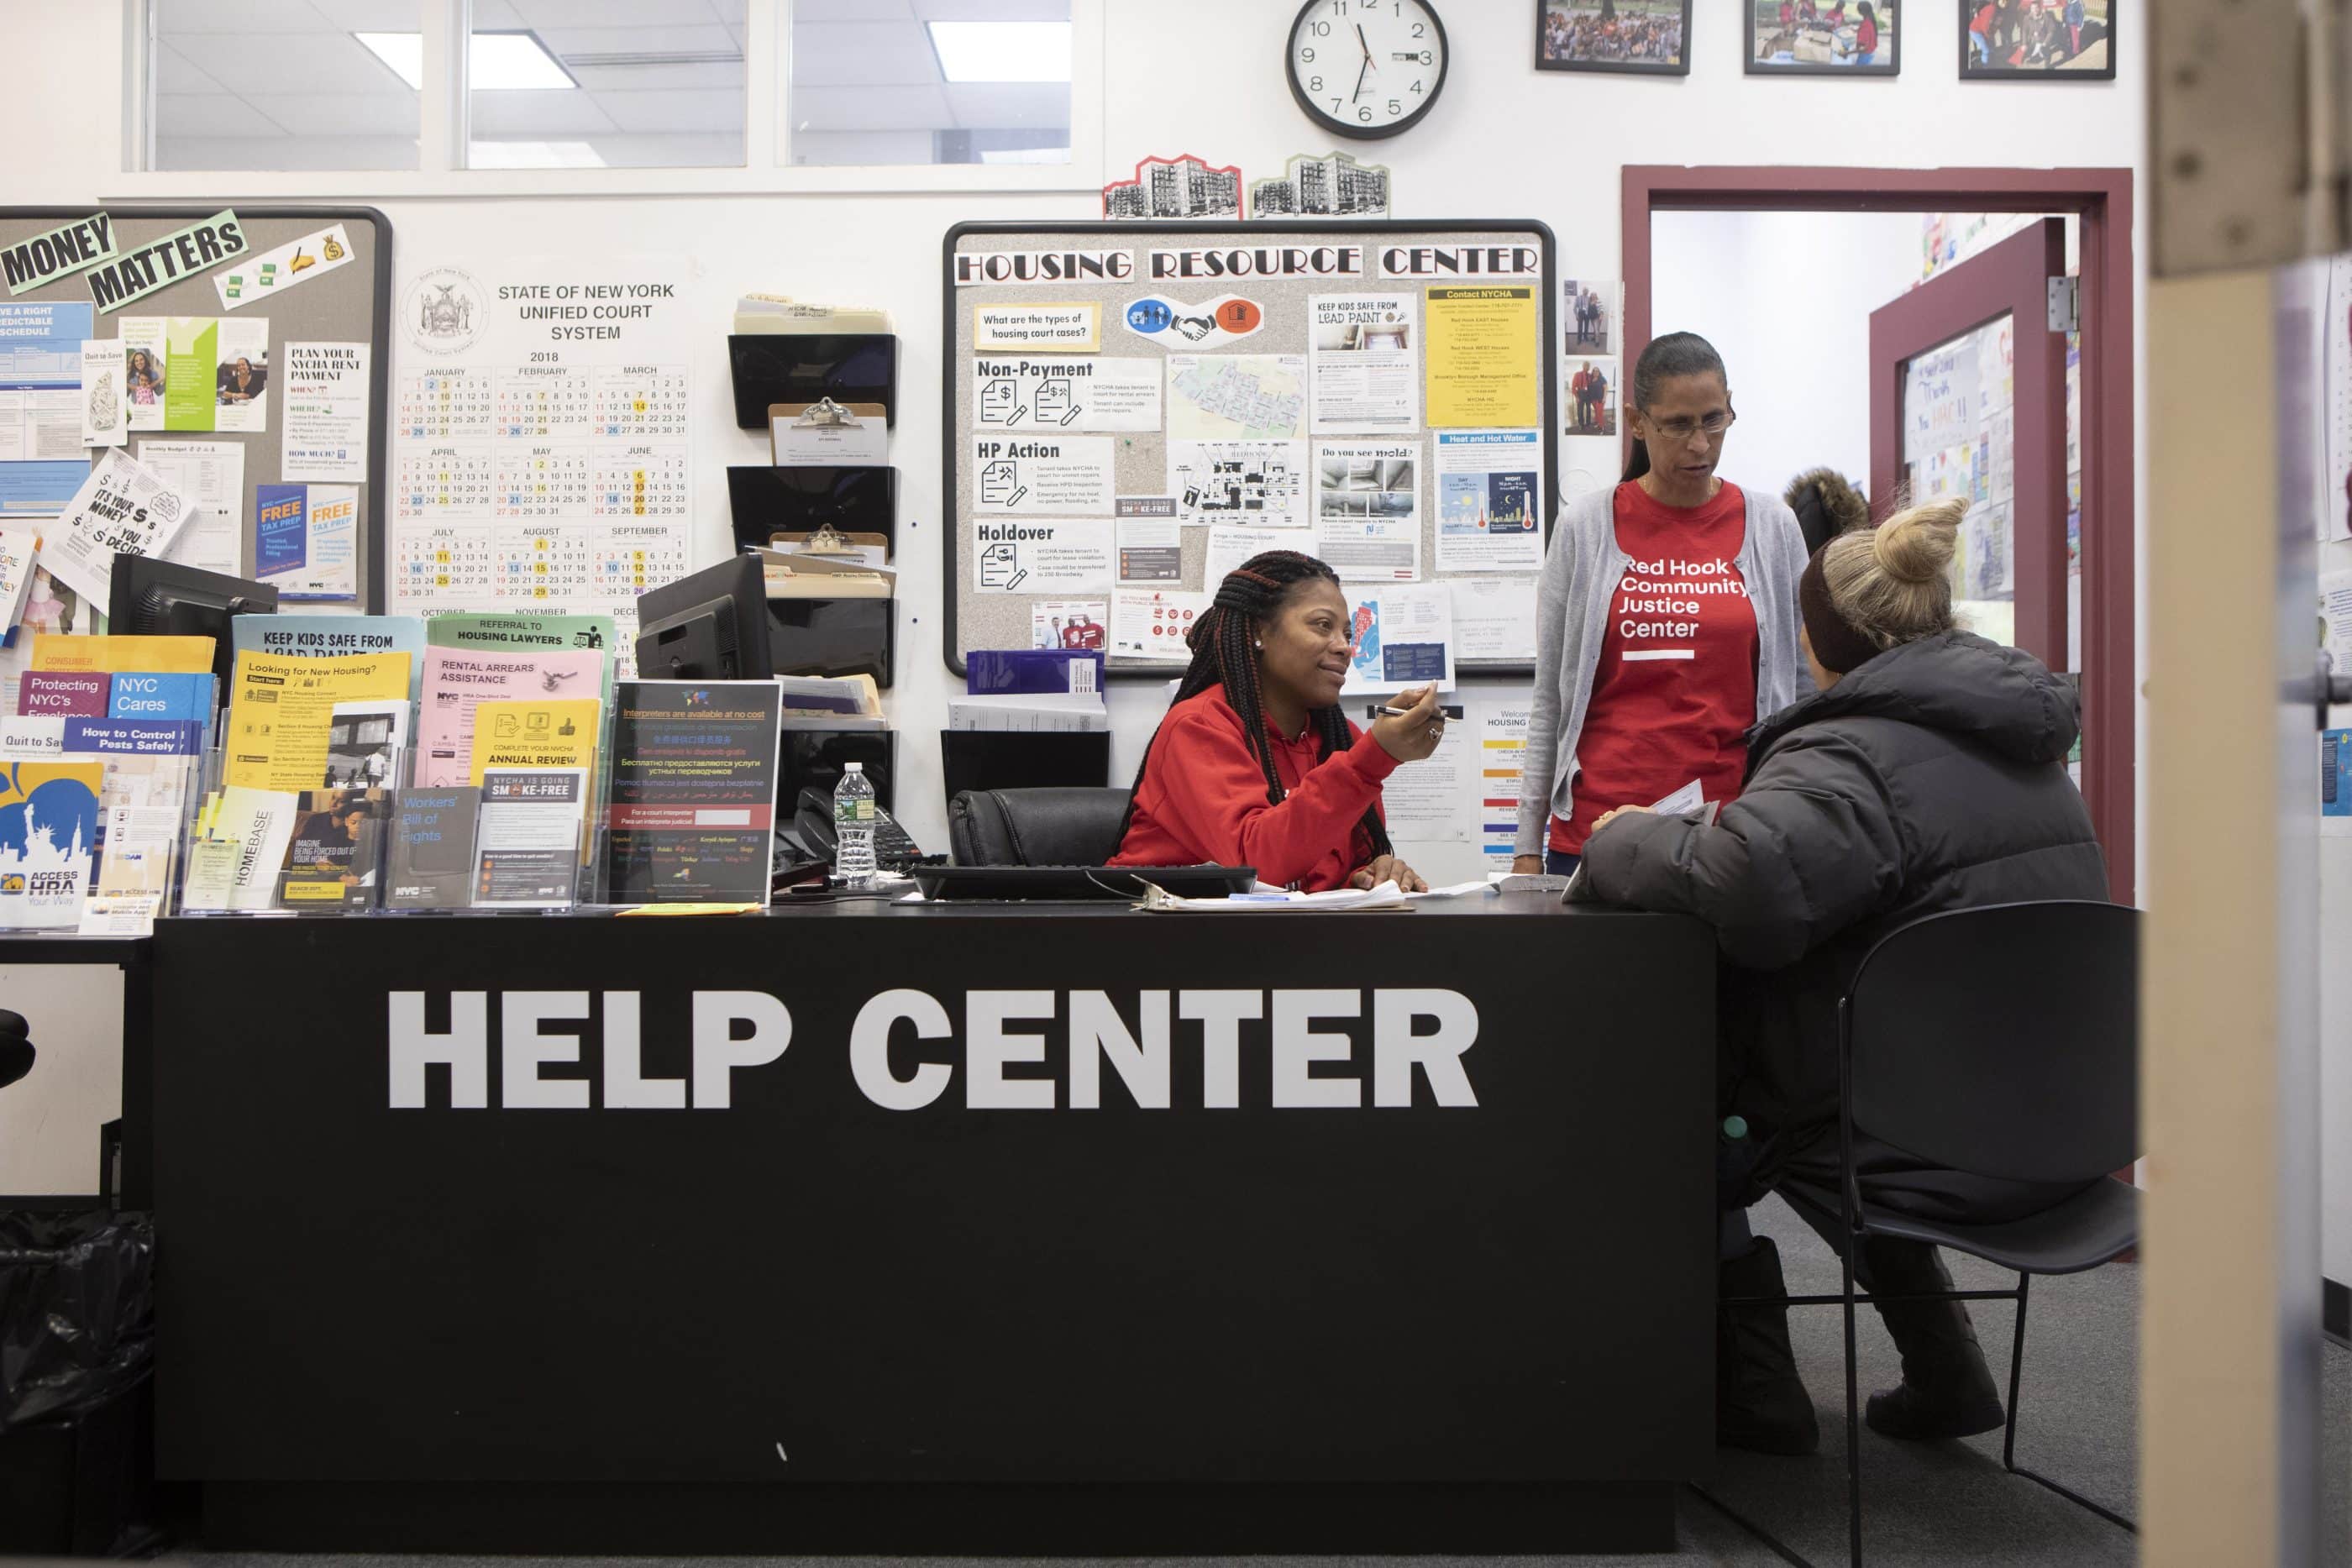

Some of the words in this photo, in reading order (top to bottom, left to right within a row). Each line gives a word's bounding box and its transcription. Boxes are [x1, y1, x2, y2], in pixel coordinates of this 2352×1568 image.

[1394, 3, 1399, 17] 1
[1310, 21, 1331, 36] 10
[1412, 24, 1424, 38] 2
[1302, 48, 1315, 63] 9
[1420, 50, 1431, 66] 3
[1310, 76, 1323, 91] 8
[1410, 80, 1422, 94] 4
[1331, 98, 1341, 113] 7
[1389, 100, 1401, 114] 5
[1358, 107, 1372, 121] 6
[2, 215, 110, 286] MONEY
[87, 223, 243, 308] MATTERS
[958, 252, 1132, 281] HOUSING
[1152, 248, 1361, 279] RESOURCE
[1383, 248, 1538, 275] CENTER
[499, 286, 549, 299] STATE
[557, 286, 579, 299] OF
[585, 285, 623, 299] NEW
[627, 285, 675, 298] YORK
[1446, 291, 1479, 299] Contact
[1481, 290, 1512, 298] NYCHA
[520, 306, 588, 319] UNIFIED
[593, 306, 653, 318] COURT
[1318, 302, 1335, 311] KEEP
[1338, 302, 1355, 311] KIDS
[1357, 302, 1374, 310] SAFE
[984, 315, 1008, 325] What
[1028, 315, 1042, 323] the
[1045, 315, 1068, 327] types
[1068, 313, 1082, 323] of
[1349, 312, 1381, 323] PAINT
[551, 327, 621, 340] SYSTEM
[992, 328, 1028, 339] housing
[1031, 328, 1054, 337] court
[1056, 328, 1086, 337] cases?
[291, 349, 319, 358] PLAN
[323, 349, 354, 359] YOUR
[530, 352, 559, 362] 2018
[291, 360, 328, 370] NYCHA
[333, 360, 360, 370] RENT
[978, 361, 1093, 379] Non-Payment
[291, 371, 341, 380] PAYMENT
[978, 443, 1001, 458] HP
[1008, 443, 1060, 458] Action
[1322, 448, 1335, 457] Do
[1337, 450, 1354, 459] you
[1375, 448, 1413, 458] mold?
[111, 495, 134, 514] YOUR
[88, 501, 128, 523] MONEY
[261, 501, 301, 523] FREE
[312, 501, 352, 523] FREE
[261, 522, 277, 531] TAX
[281, 517, 301, 527] PREP
[612, 527, 667, 535] SEPTEMBER
[121, 527, 142, 544] YOU
[979, 524, 1054, 540] Holdover
[106, 537, 147, 556] DECIDE
[1670, 559, 1730, 575] Hook
[1621, 577, 1747, 598] Community
[1620, 596, 1699, 614] Justice
[480, 620, 528, 630] REFERRAL
[1620, 620, 1698, 638] Center
[264, 632, 293, 645] KEEP
[297, 633, 324, 647] KIDS
[328, 634, 356, 648] SAFE
[361, 635, 393, 648] FROM
[458, 631, 507, 642] HOUSING
[511, 634, 563, 645] LAWYERS
[249, 663, 290, 676] Looking
[293, 667, 307, 675] for
[333, 665, 376, 676] Housing?
[442, 661, 483, 671] RENTAL
[486, 663, 534, 673] ARREARS
[31, 678, 98, 693] Protecting
[118, 678, 157, 692] NYC
[440, 674, 507, 684] ASSISTANCE
[29, 695, 71, 705] NYC's
[437, 692, 459, 700] NYC
[117, 697, 166, 711] Cares
[623, 709, 670, 718] Interpreters
[687, 710, 723, 718] available
[82, 727, 109, 737] How
[113, 729, 126, 738] to
[131, 729, 176, 739] Control
[6, 735, 28, 747] Quit
[31, 736, 41, 746] to
[45, 737, 64, 747] Sav
[99, 739, 133, 750] Pests
[137, 740, 175, 753] Safely
[489, 755, 533, 764] ANNUAL
[537, 756, 577, 764] REVIEW
[622, 758, 663, 767] Бесплатно
[664, 759, 733, 768] предоставляются
[734, 759, 760, 768] услуги
[403, 796, 457, 808] Workers'
[403, 814, 420, 825] Bill
[424, 814, 438, 825] of
[235, 810, 268, 887] HOMEBASE
[30, 871, 78, 881] ACCESS
[28, 897, 47, 906] Your
[53, 896, 75, 906] Way
[389, 989, 794, 1109] HELP
[849, 988, 1481, 1111] CENTER
